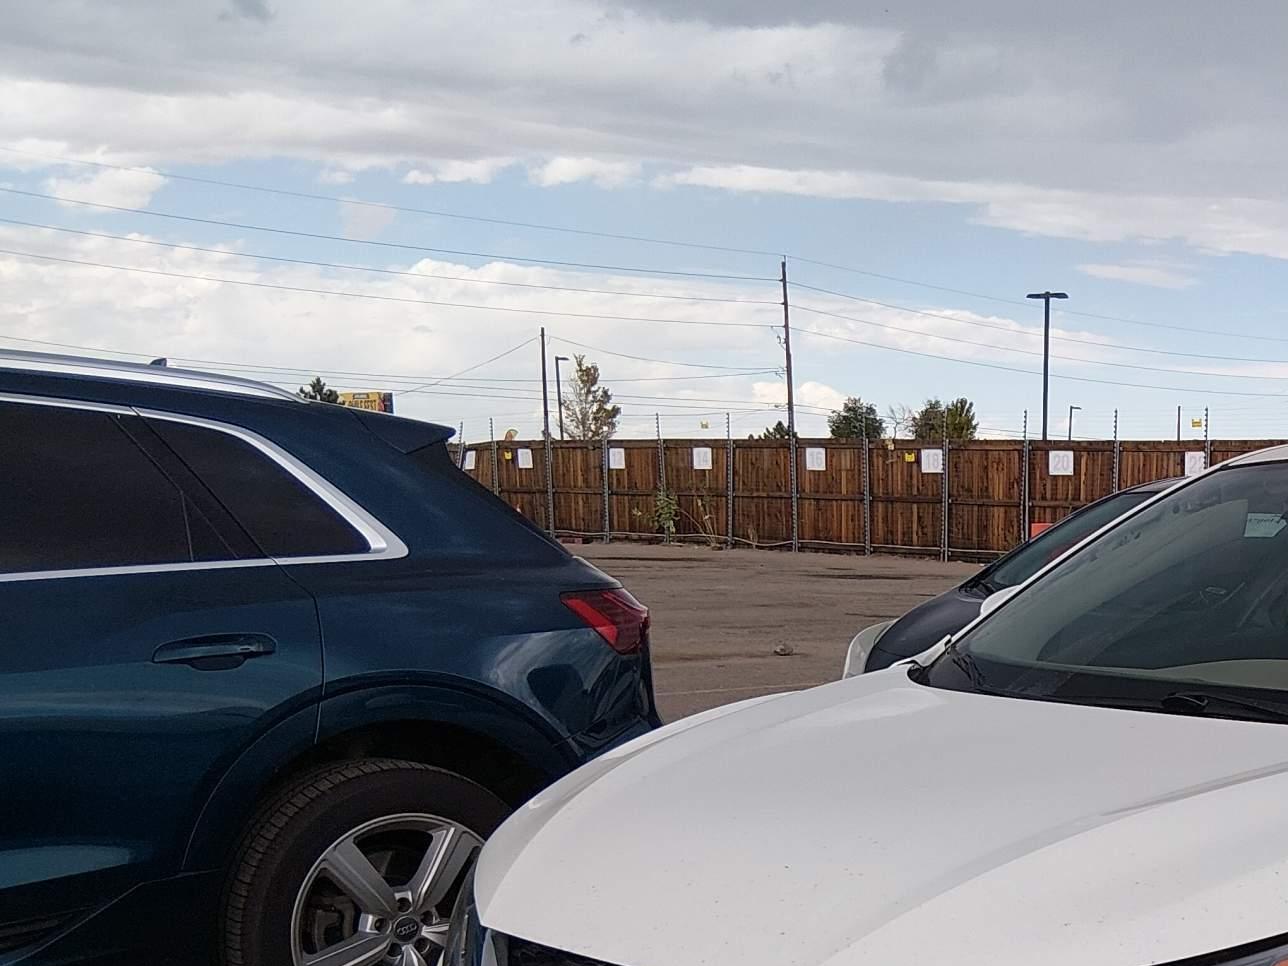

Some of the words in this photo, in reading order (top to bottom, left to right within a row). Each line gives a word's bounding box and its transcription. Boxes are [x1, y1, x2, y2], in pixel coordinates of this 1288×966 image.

[809, 451, 824, 468] 16
[923, 452, 940, 469] 18
[1053, 453, 1070, 471] 20
